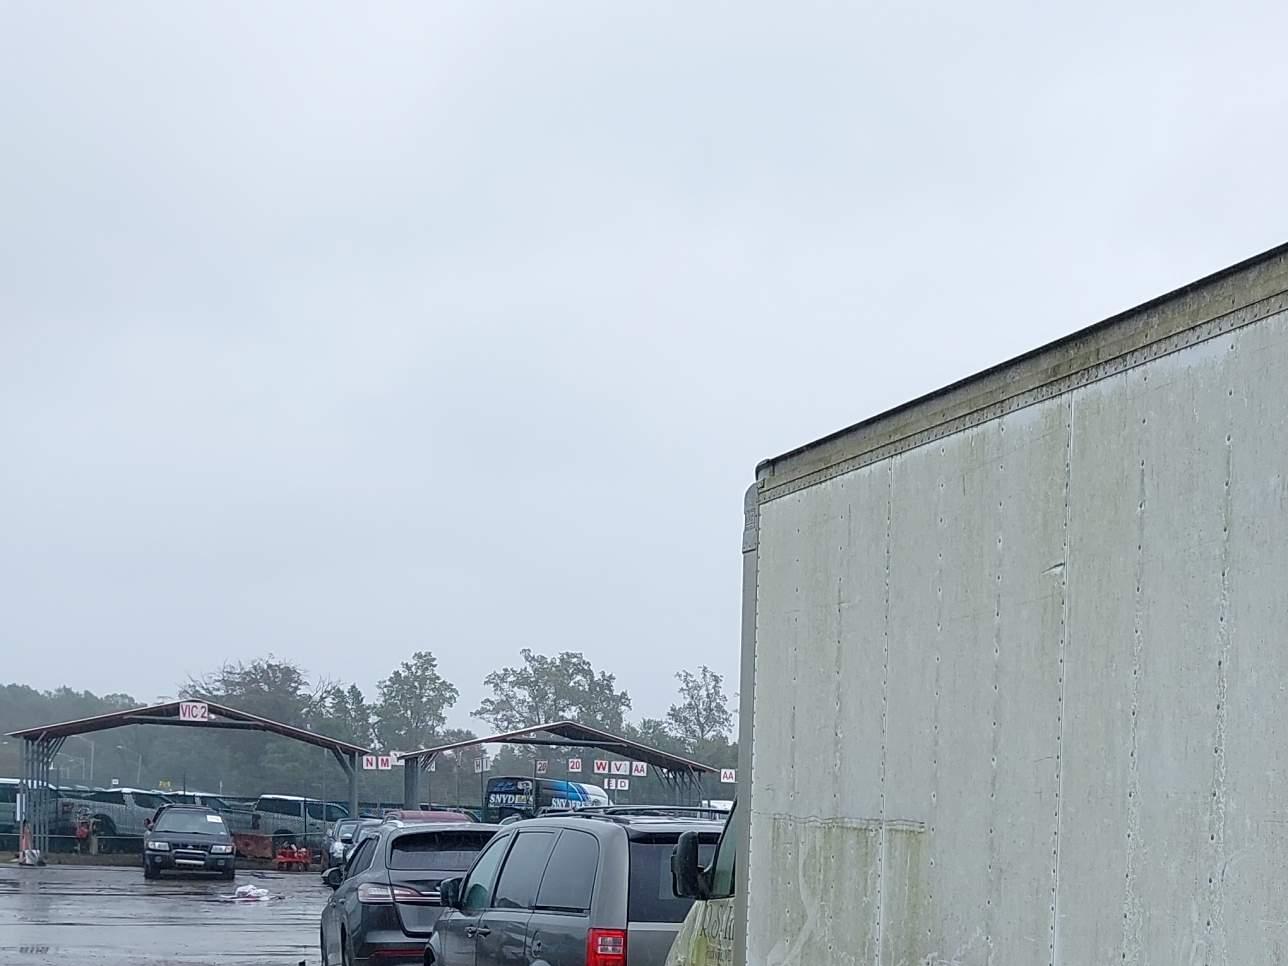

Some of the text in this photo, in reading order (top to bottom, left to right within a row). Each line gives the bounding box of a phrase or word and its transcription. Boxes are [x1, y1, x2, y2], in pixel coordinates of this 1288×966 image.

[181, 704, 208, 719] VIC 2
[366, 757, 374, 768] N
[380, 758, 389, 769] M
[569, 760, 580, 770] 20
[596, 762, 607, 772] W
[614, 763, 623, 772] V
[634, 764, 645, 774] AA
[722, 771, 734, 782] AA
